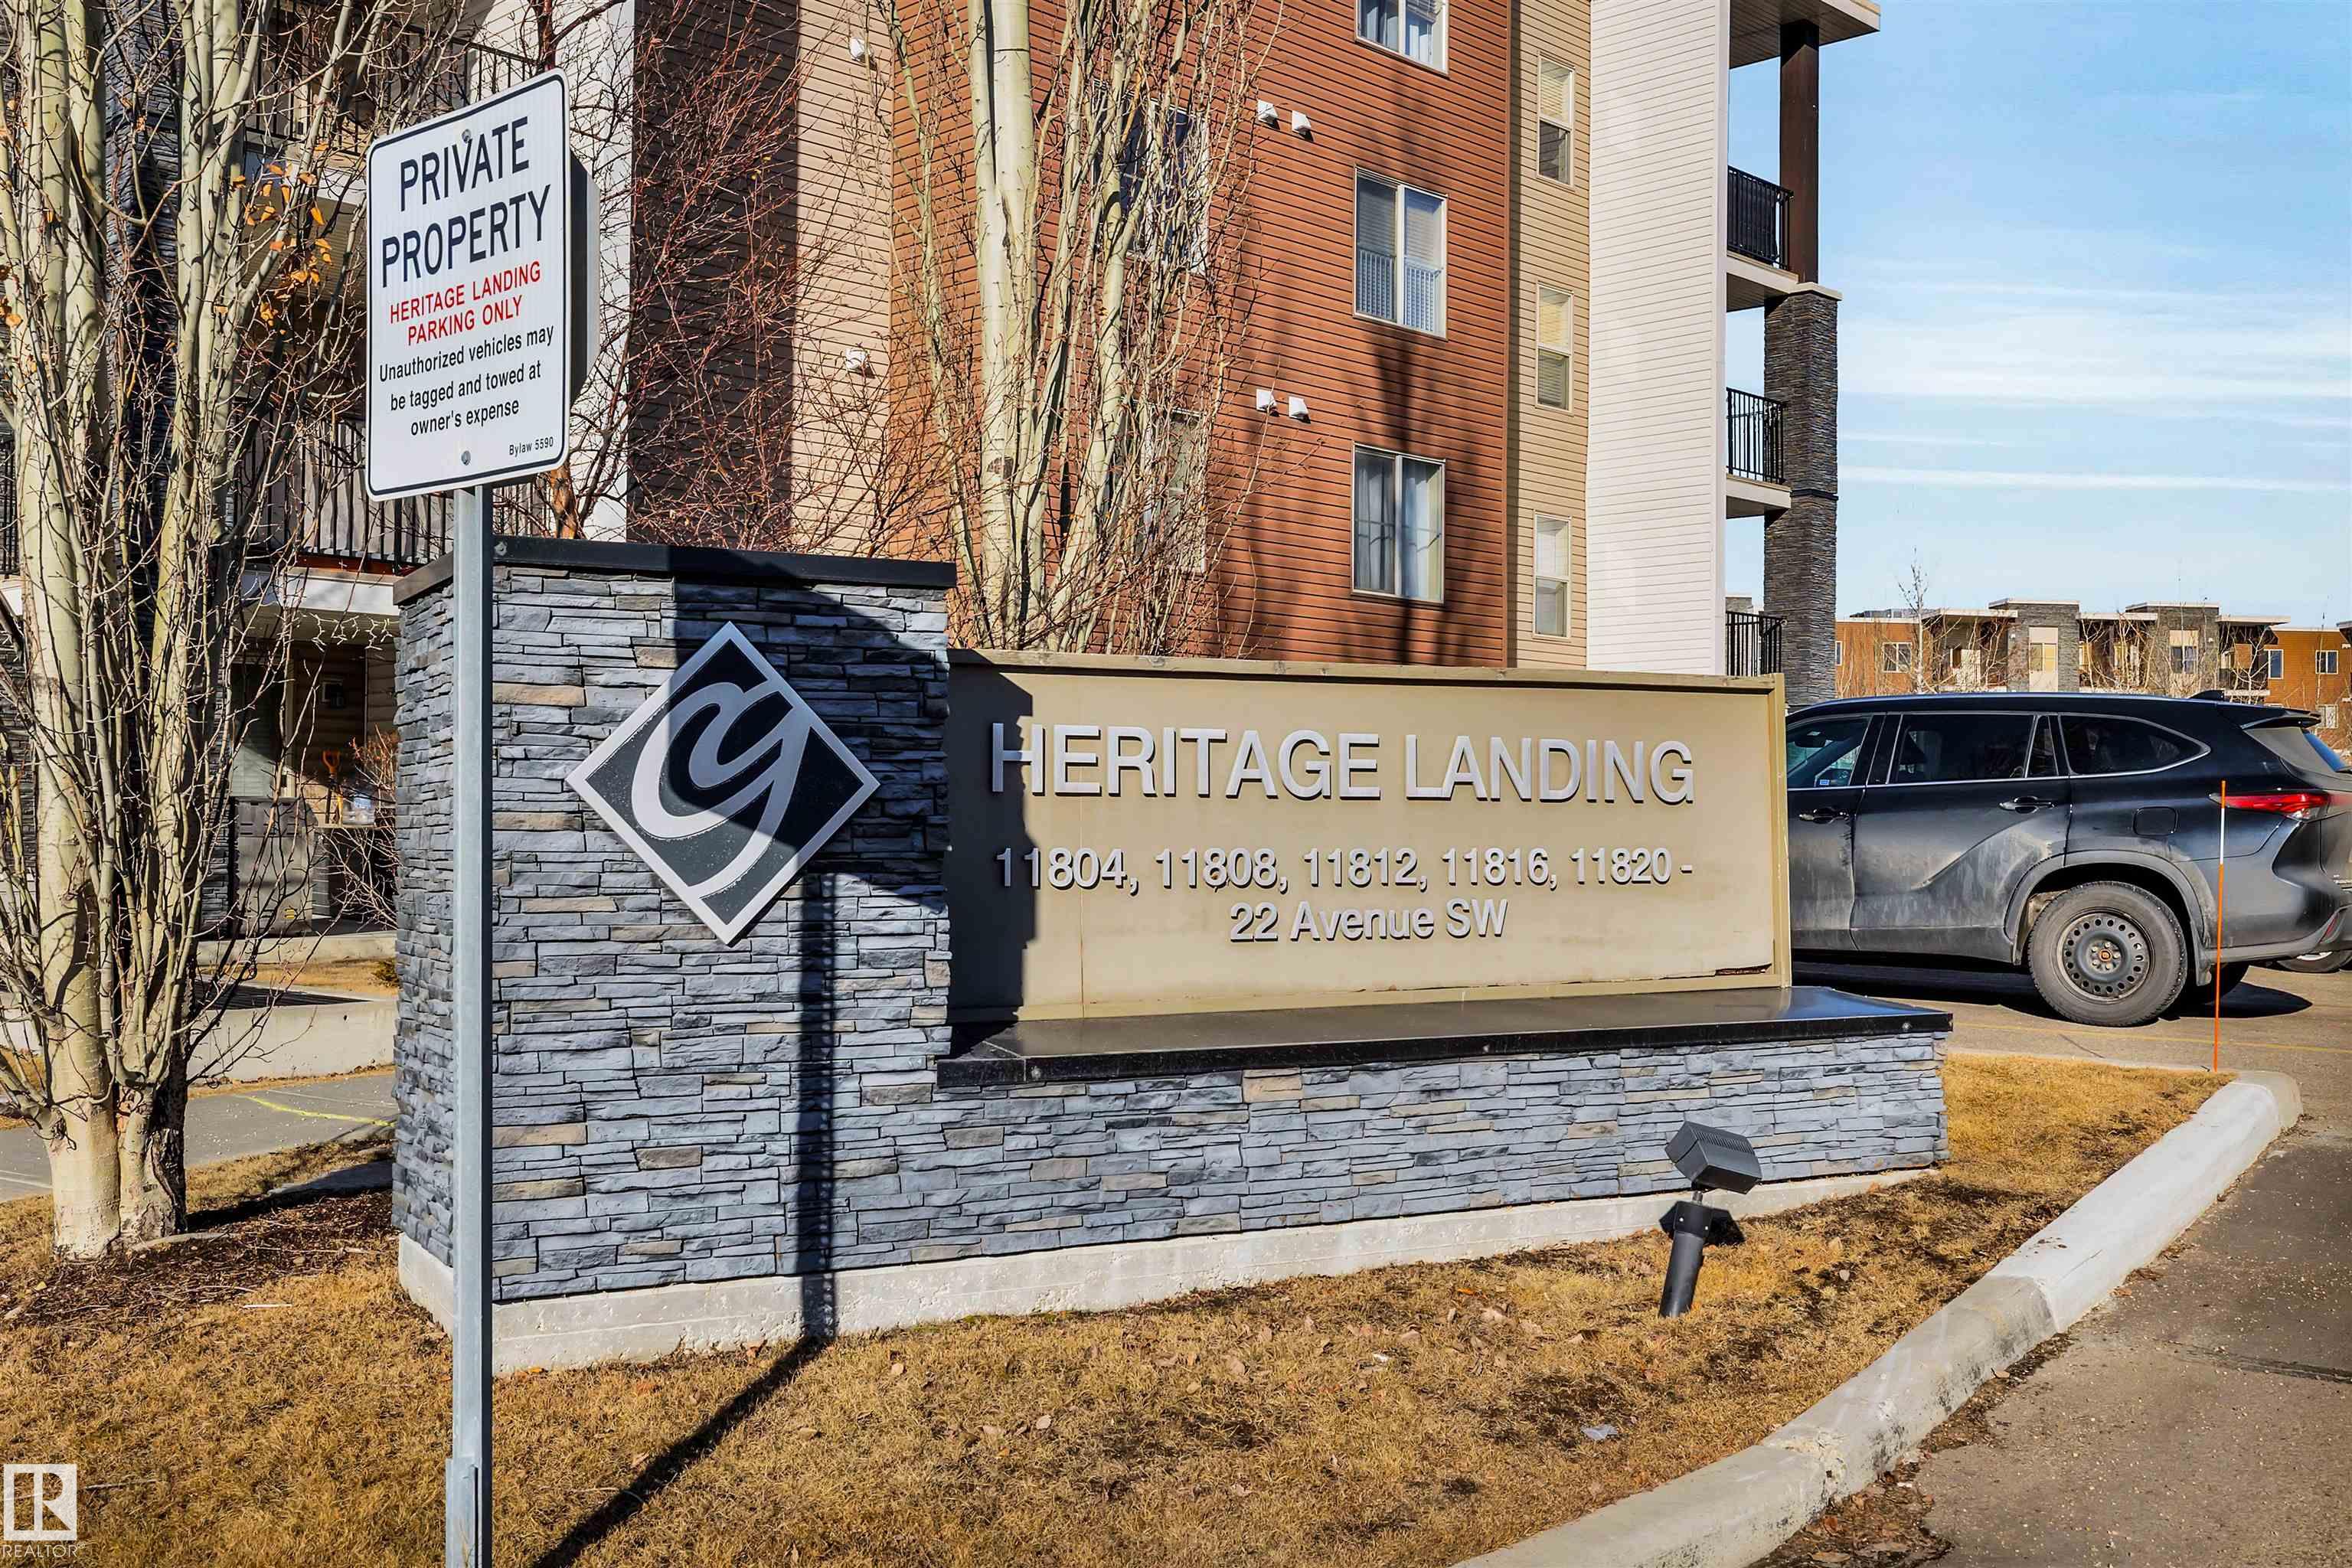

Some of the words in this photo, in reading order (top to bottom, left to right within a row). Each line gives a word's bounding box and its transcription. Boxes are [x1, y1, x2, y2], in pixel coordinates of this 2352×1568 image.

[400, 116, 530, 212] PRIVATE
[382, 184, 551, 288] PROPERTY
[390, 284, 466, 324] HERITAGE
[472, 260, 541, 301] LANDING
[408, 309, 475, 346] PARKING
[482, 295, 522, 325] ONLY
[379, 346, 464, 382] Unauthorized
[469, 334, 521, 361] vehicles
[527, 325, 554, 346] may
[390, 394, 406, 411] be
[410, 381, 453, 410] tagged
[459, 374, 482, 397] and
[486, 364, 524, 390] towed
[529, 360, 541, 380] at
[411, 410, 462, 436] owner's
[466, 400, 519, 426] expense
[509, 443, 532, 457] Bylaw
[534, 436, 554, 450] 5590
[991, 722, 1380, 801] HERITAGE
[1405, 733, 1694, 805] LANDING
[996, 847, 1139, 895] 11804,
[1155, 848, 1289, 894] 11808,
[1303, 848, 1428, 892] 11812,
[1441, 847, 1558, 890] 11816,
[1570, 847, 1671, 885] 11820
[1230, 902, 1279, 943] 22
[1290, 900, 1435, 941] Avenue
[1446, 898, 1508, 939] SW
